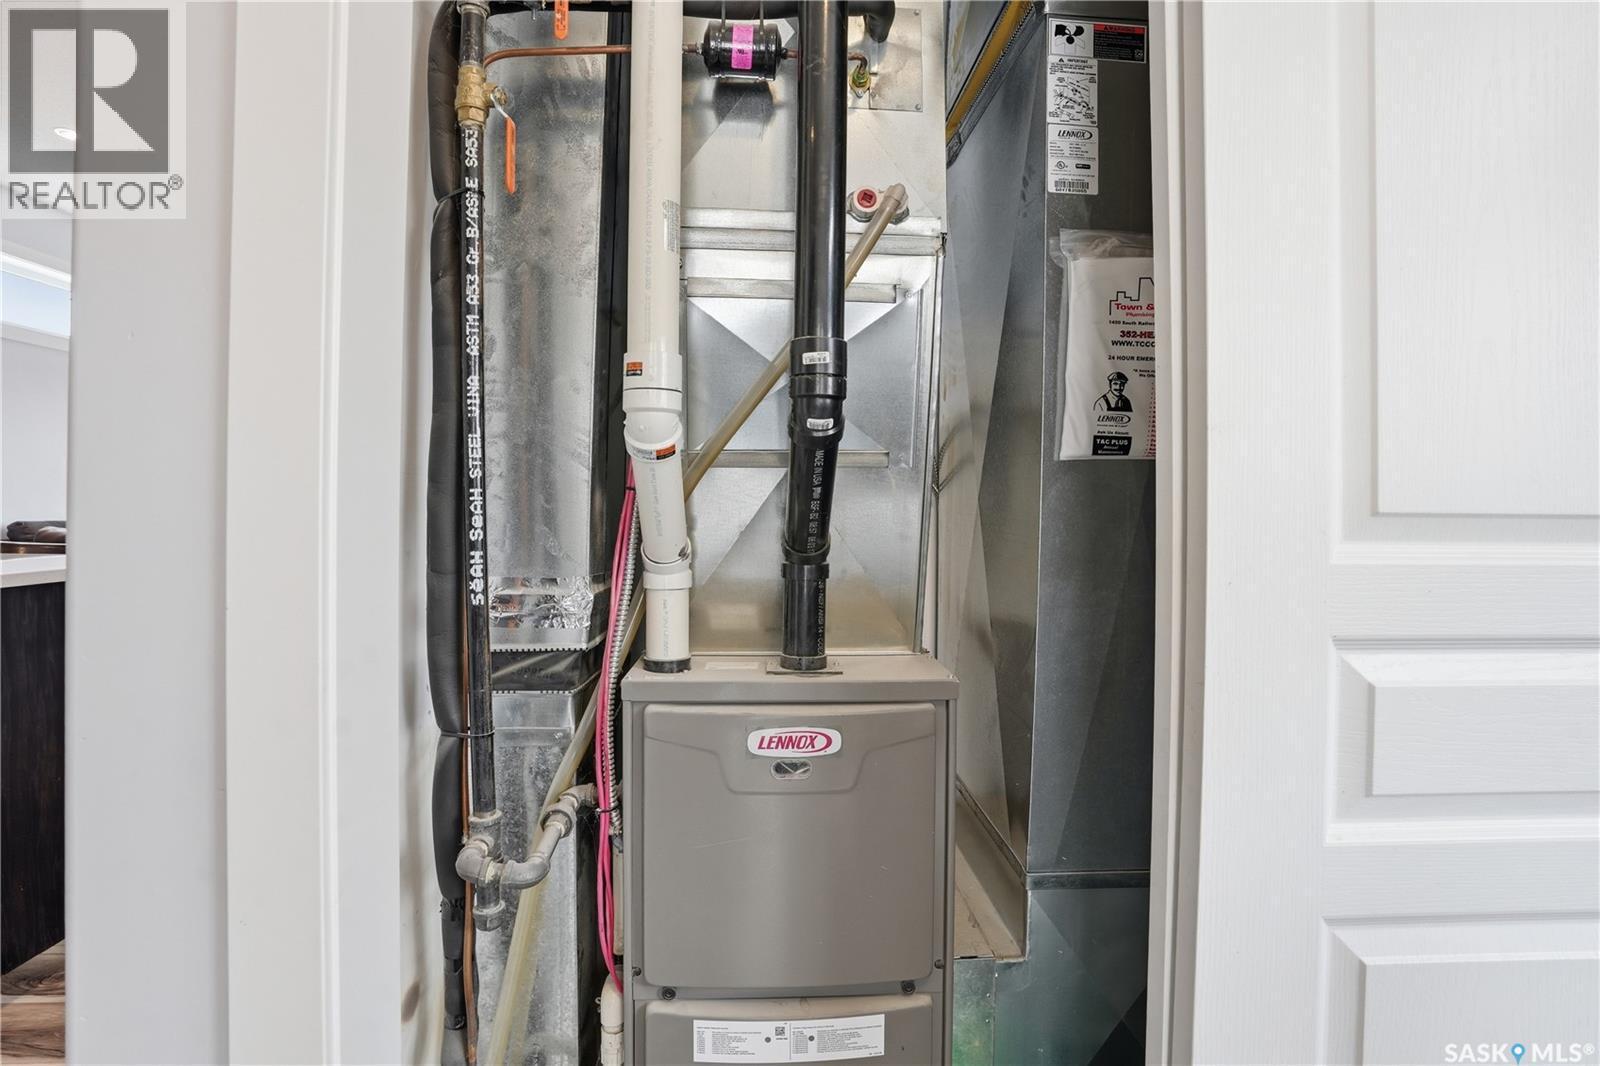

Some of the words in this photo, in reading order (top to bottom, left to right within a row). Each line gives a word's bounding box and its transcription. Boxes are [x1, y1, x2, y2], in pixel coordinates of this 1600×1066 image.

[466, 273, 480, 305] A53
[466, 314, 480, 356] ASTM
[757, 735, 819, 750] LENNOX
